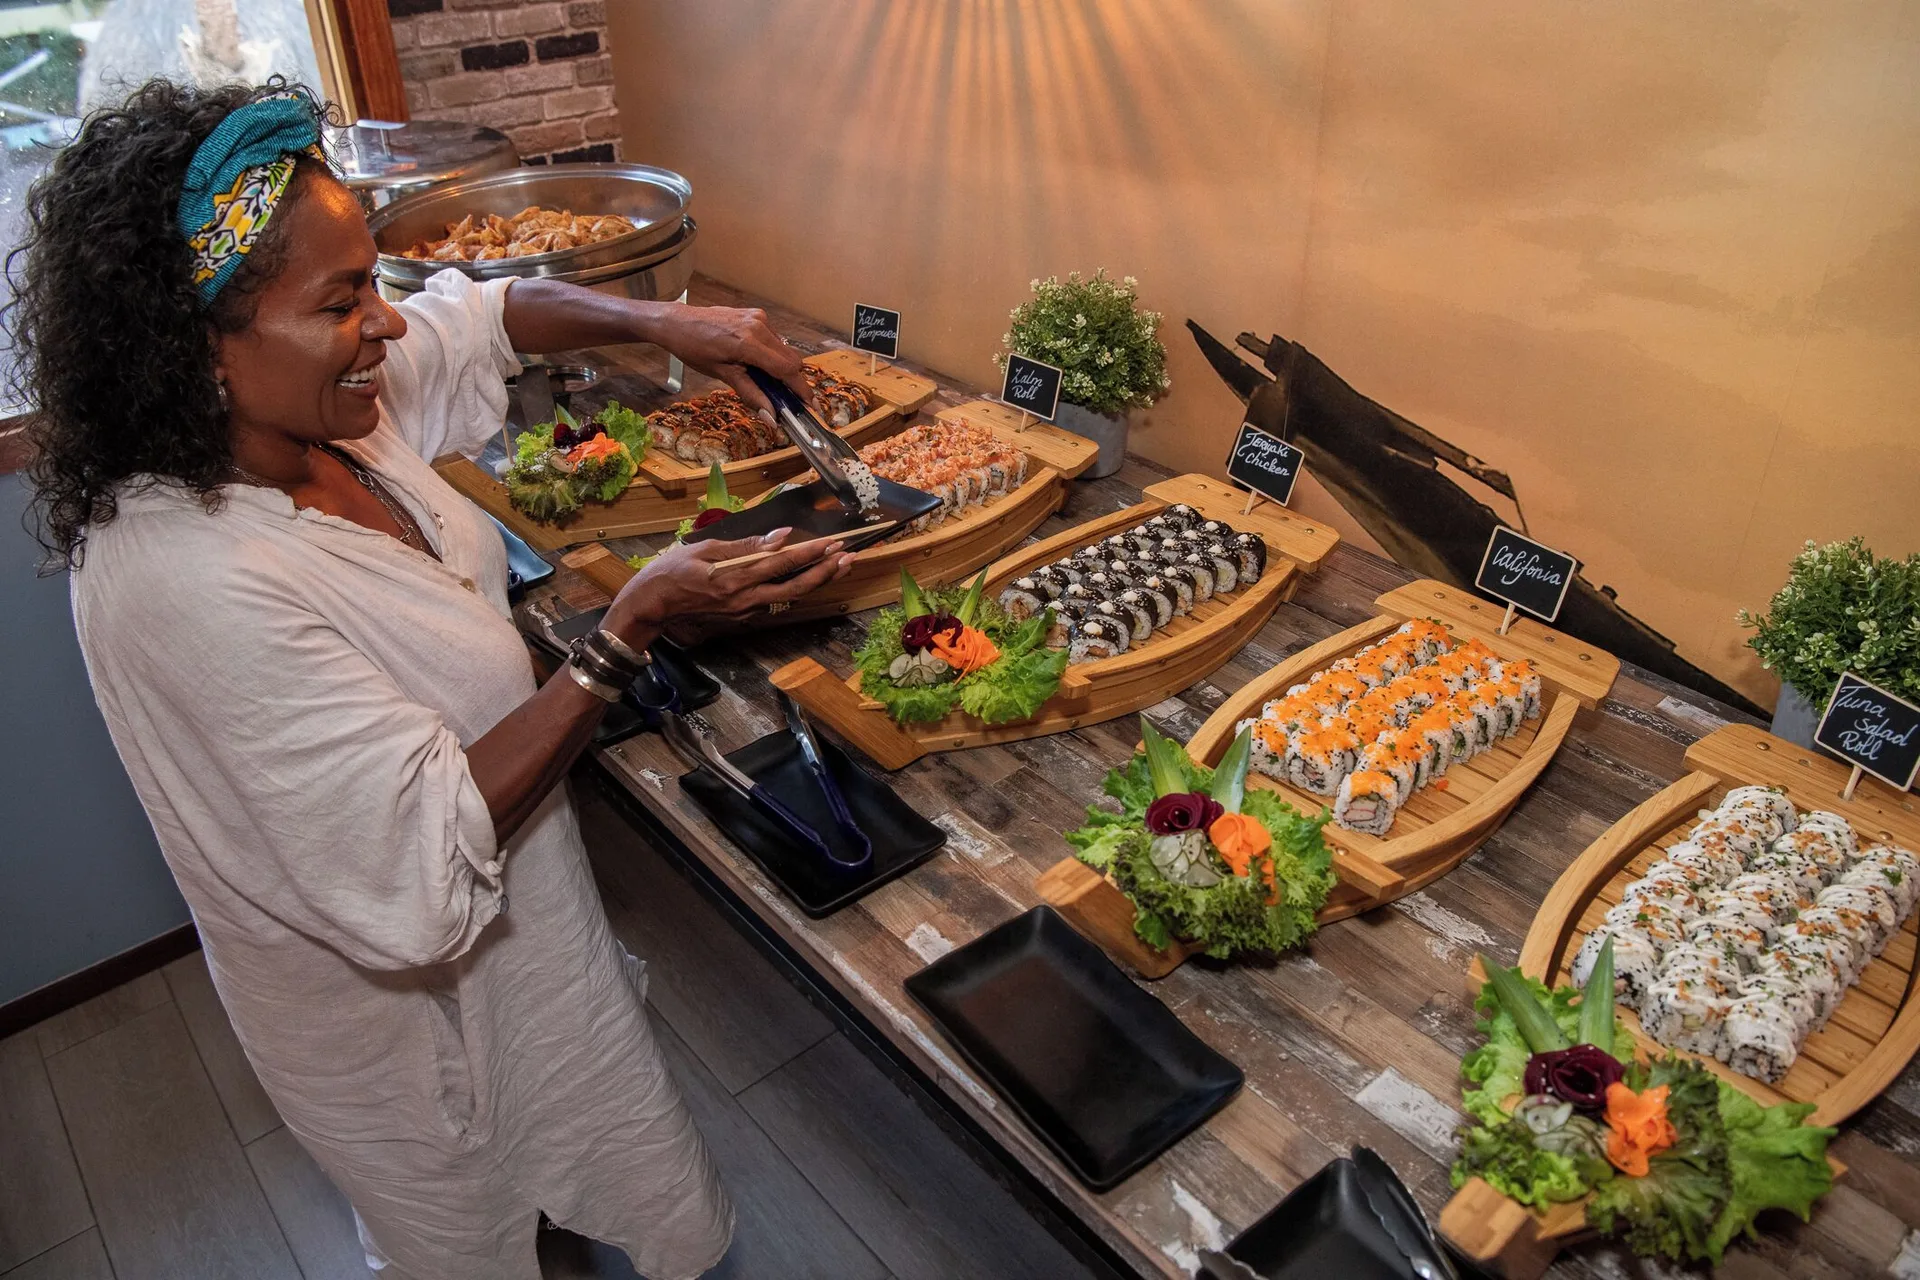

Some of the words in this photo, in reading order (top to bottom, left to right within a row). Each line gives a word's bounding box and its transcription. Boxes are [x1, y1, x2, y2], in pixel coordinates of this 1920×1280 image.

[1011, 384, 1038, 400] Roll
[1244, 451, 1290, 476] Chicken
[1492, 545, 1562, 585] Califonia
[1828, 685, 1887, 718] Tuna
[1838, 730, 1883, 760] Roll
[1854, 718, 1918, 746] Salad
